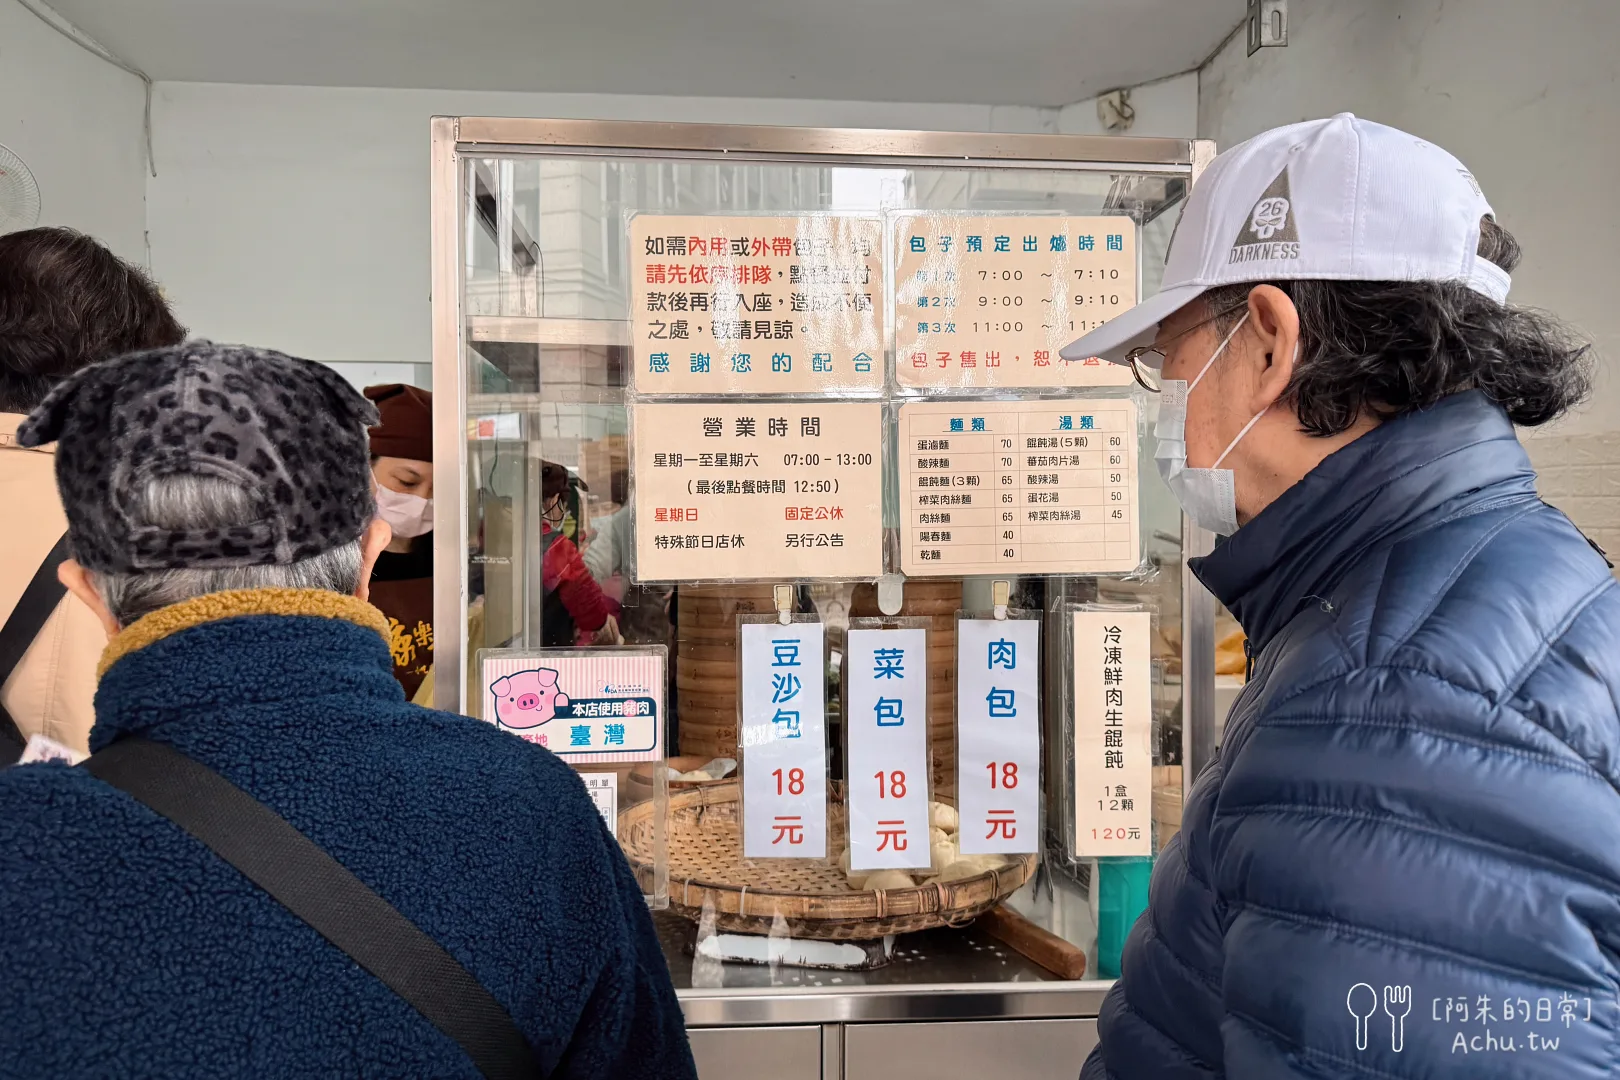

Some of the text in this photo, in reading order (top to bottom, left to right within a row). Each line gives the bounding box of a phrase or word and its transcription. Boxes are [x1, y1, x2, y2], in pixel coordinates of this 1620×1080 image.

[1258, 200, 1283, 217] 26
[1228, 242, 1300, 264] DARKNESS
[978, 270, 1023, 281] 7:00
[1074, 268, 1119, 280] 7:10
[917, 296, 956, 307] 第2次
[978, 295, 1023, 307] 9:00
[1074, 294, 1119, 306] 9:10
[917, 322, 956, 334] 第3次
[973, 321, 1023, 333] 11:00
[649, 352, 873, 373] 感謝您的配合
[703, 416, 821, 438] 營業時間
[950, 417, 985, 432] 麵類
[1059, 415, 1094, 430] 湯類
[917, 439, 1012, 450] 蛋滷麵 70
[1110, 437, 1121, 446] 60
[653, 452, 759, 468] 星期一至星期六
[918, 458, 1012, 469] 酸辣麵 70
[1110, 455, 1121, 464] 60
[1001, 476, 1012, 485] 65
[1027, 474, 1121, 485] 酸辣湯 50
[919, 494, 1013, 505] 榨菜肉絲麵 65
[1027, 492, 1122, 503] 蛋花湯 50
[654, 506, 844, 522] 星期日 固定公休
[919, 512, 1013, 524] 肉絲麵 65
[1028, 510, 1122, 522] 榨菜肉絲湯 45
[654, 533, 844, 550] 特殊節日店休 另行公告
[920, 530, 1014, 542] 陽春麵 40
[920, 549, 1014, 560] 乾麵 40
[1103, 625, 1124, 769] 冷凍鮮肉生餛飩
[572, 701, 650, 717] 本店使用豬肉
[570, 723, 625, 746] 臺灣
[985, 638, 1018, 840] 肉包 18 元
[771, 639, 805, 844] 豆沙包 18 元
[873, 648, 908, 851] 菜包 18 元
[1104, 784, 1128, 797] 1盒
[1097, 798, 1134, 812] 12顆
[1091, 827, 1141, 840] 120元
